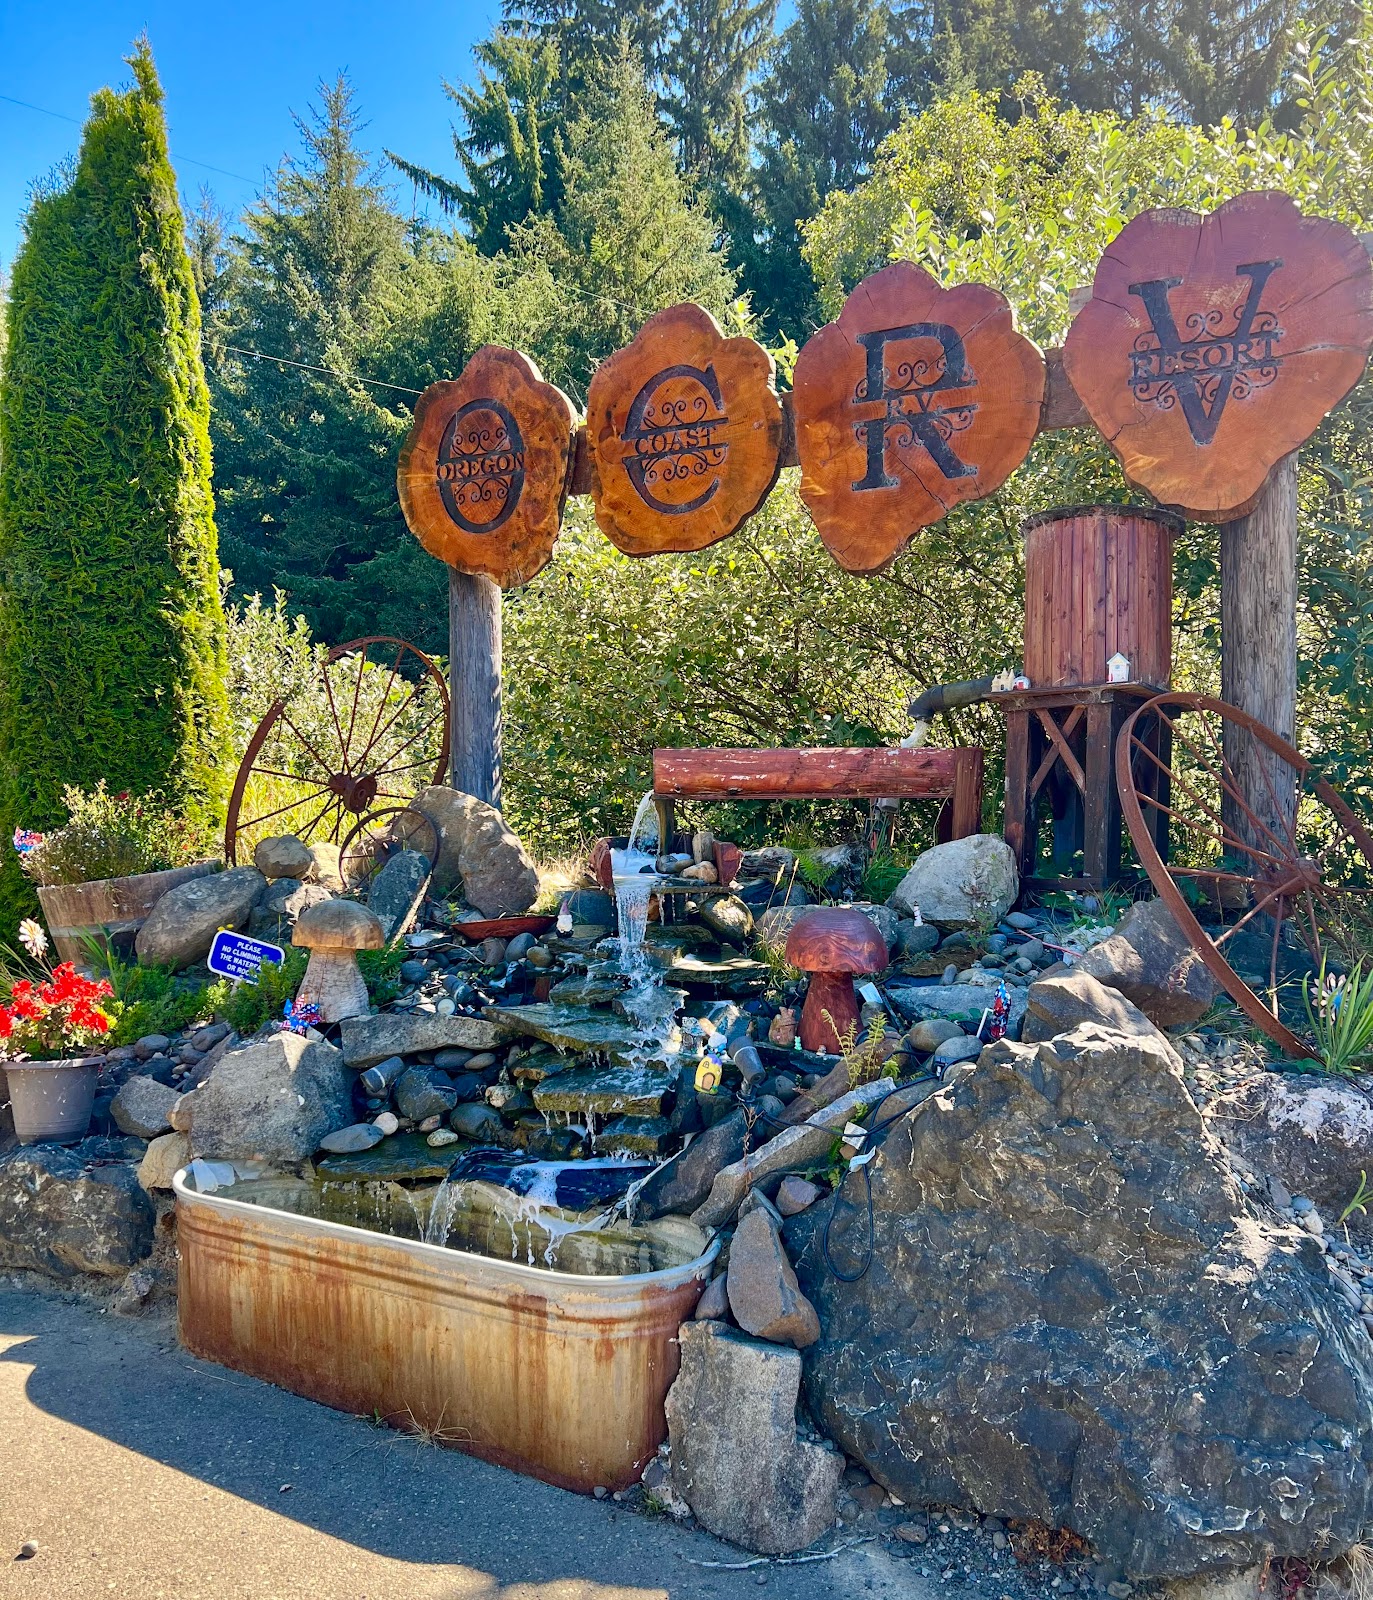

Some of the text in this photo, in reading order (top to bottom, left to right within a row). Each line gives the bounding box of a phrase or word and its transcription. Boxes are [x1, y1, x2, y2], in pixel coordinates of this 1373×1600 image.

[1128, 257, 1284, 446] V
[1130, 334, 1280, 380] RESORT
[852, 321, 978, 492] R
[621, 362, 729, 514] C
[634, 427, 717, 456] COAST
[436, 450, 525, 481] OREGON
[438, 398, 525, 533] O
[220, 953, 232, 962] THE
[233, 957, 262, 971] WATERFA
[221, 945, 262, 962] NO CLIMBING
[237, 941, 262, 954] PLEASE
[226, 964, 236, 972] OR
